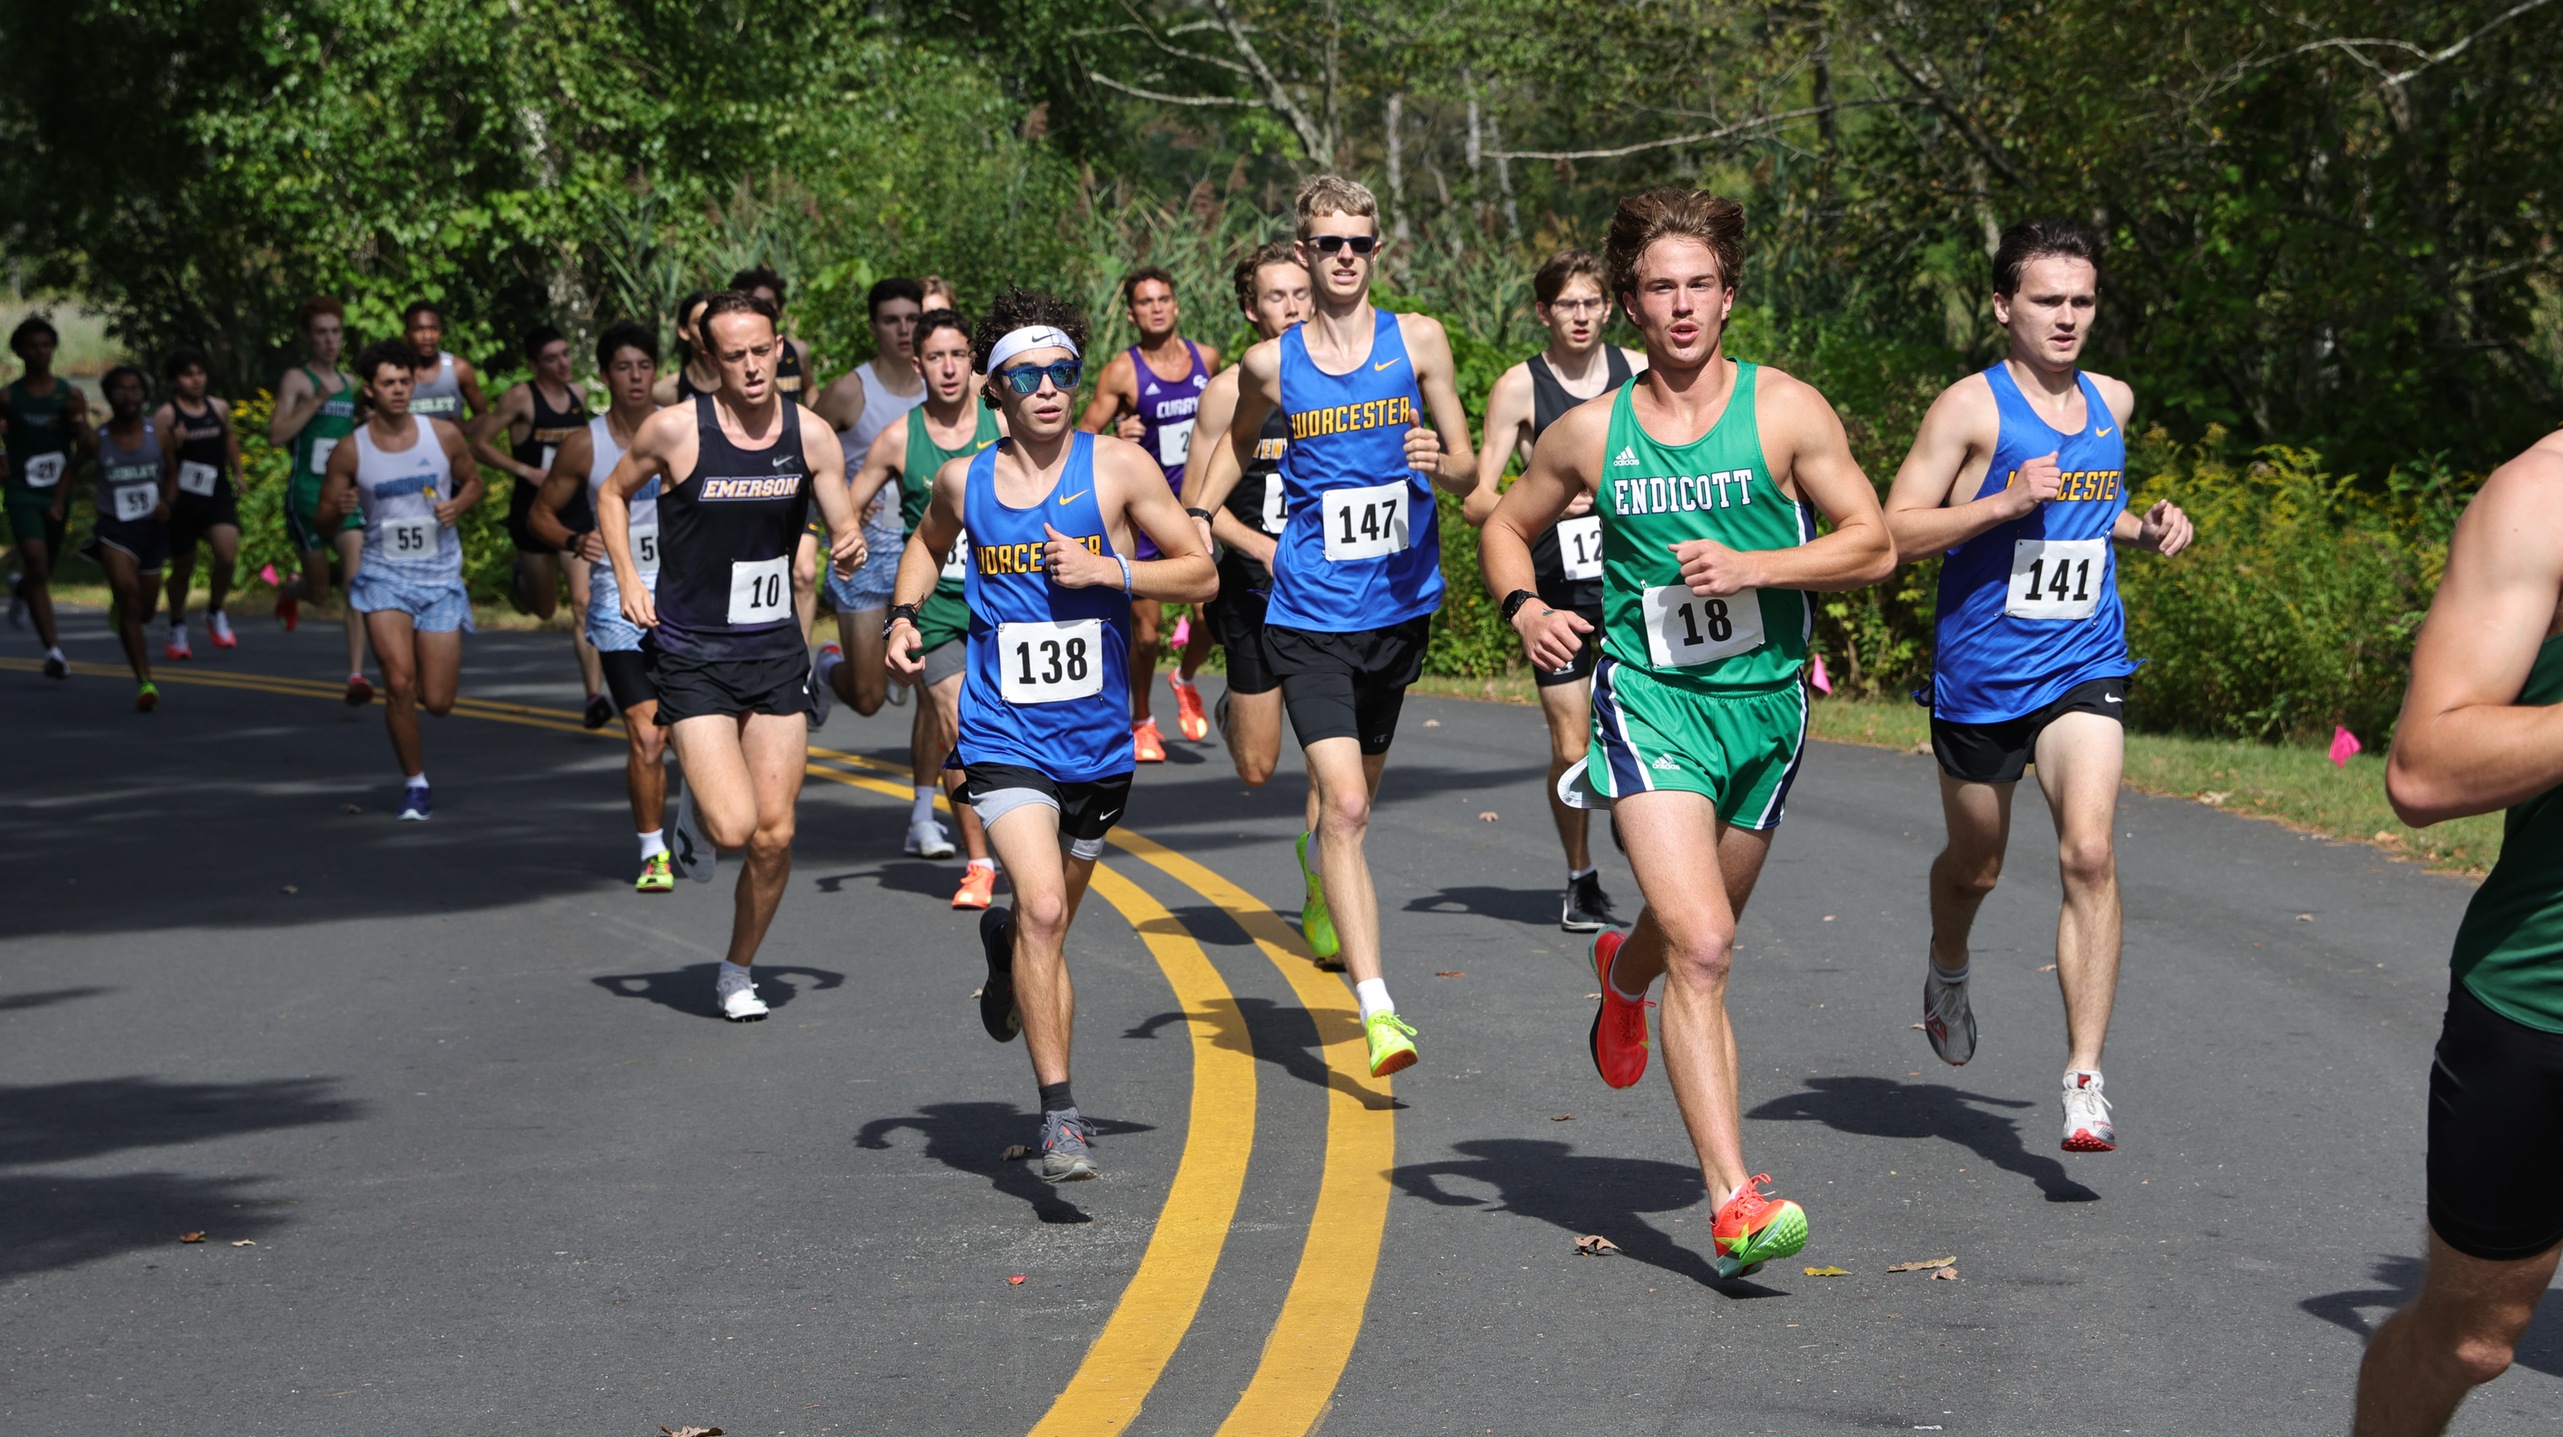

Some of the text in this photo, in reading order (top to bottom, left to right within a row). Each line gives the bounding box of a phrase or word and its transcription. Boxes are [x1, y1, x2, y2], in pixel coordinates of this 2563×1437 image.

[1291, 396, 1410, 440] WORCESTER
[1613, 459, 1640, 467] adidas
[701, 477, 801, 499] EMERSON
[1613, 468, 1753, 517] ENDICOTT
[2005, 469, 2123, 502] CESTE
[398, 527, 423, 551] 55
[1339, 498, 1397, 544] 147
[750, 573, 779, 608] 10
[2025, 558, 2090, 602] 141
[1677, 598, 1733, 647] 18
[1016, 637, 1088, 685] 138
[1652, 762, 1681, 770] adidas
